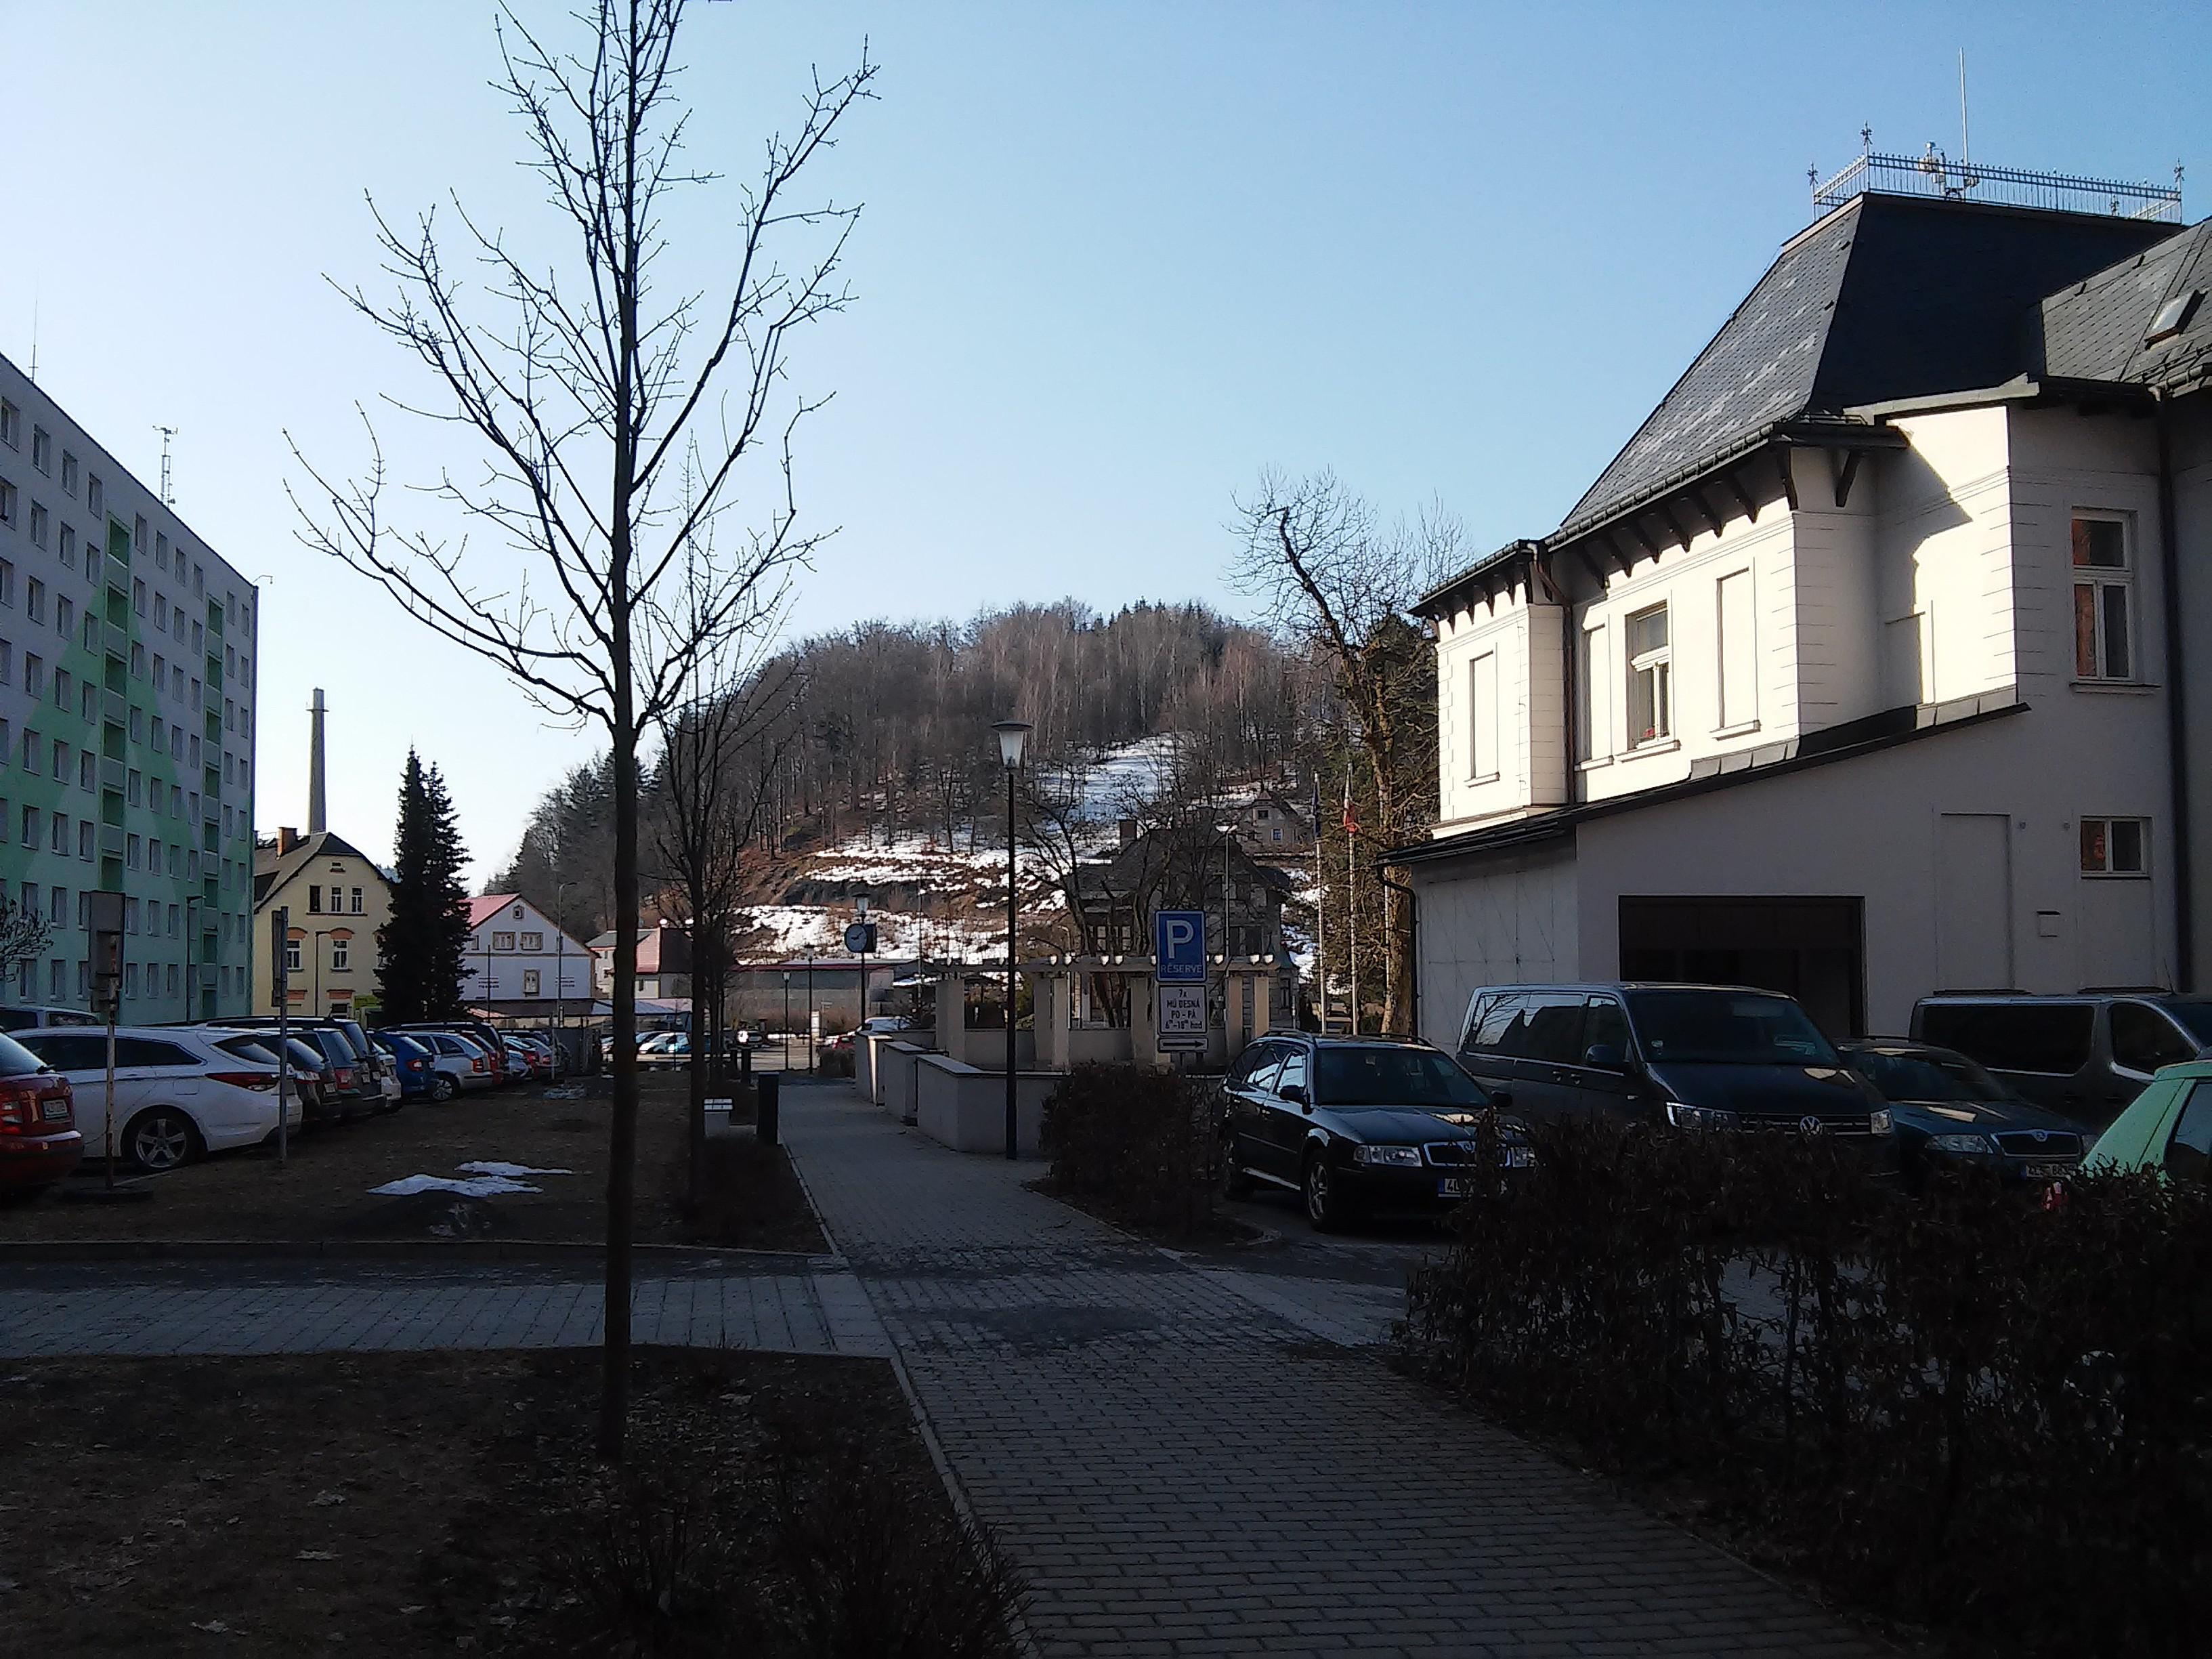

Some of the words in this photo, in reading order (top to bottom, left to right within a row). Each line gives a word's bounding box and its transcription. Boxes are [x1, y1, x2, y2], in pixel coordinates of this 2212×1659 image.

[1166, 919, 1194, 959] P
[1178, 998, 1200, 1008] DESNÁ
[1171, 1010, 1181, 1019] PO
[1187, 1009, 1197, 1019] PÁ
[1190, 1020, 1203, 1030] hod
